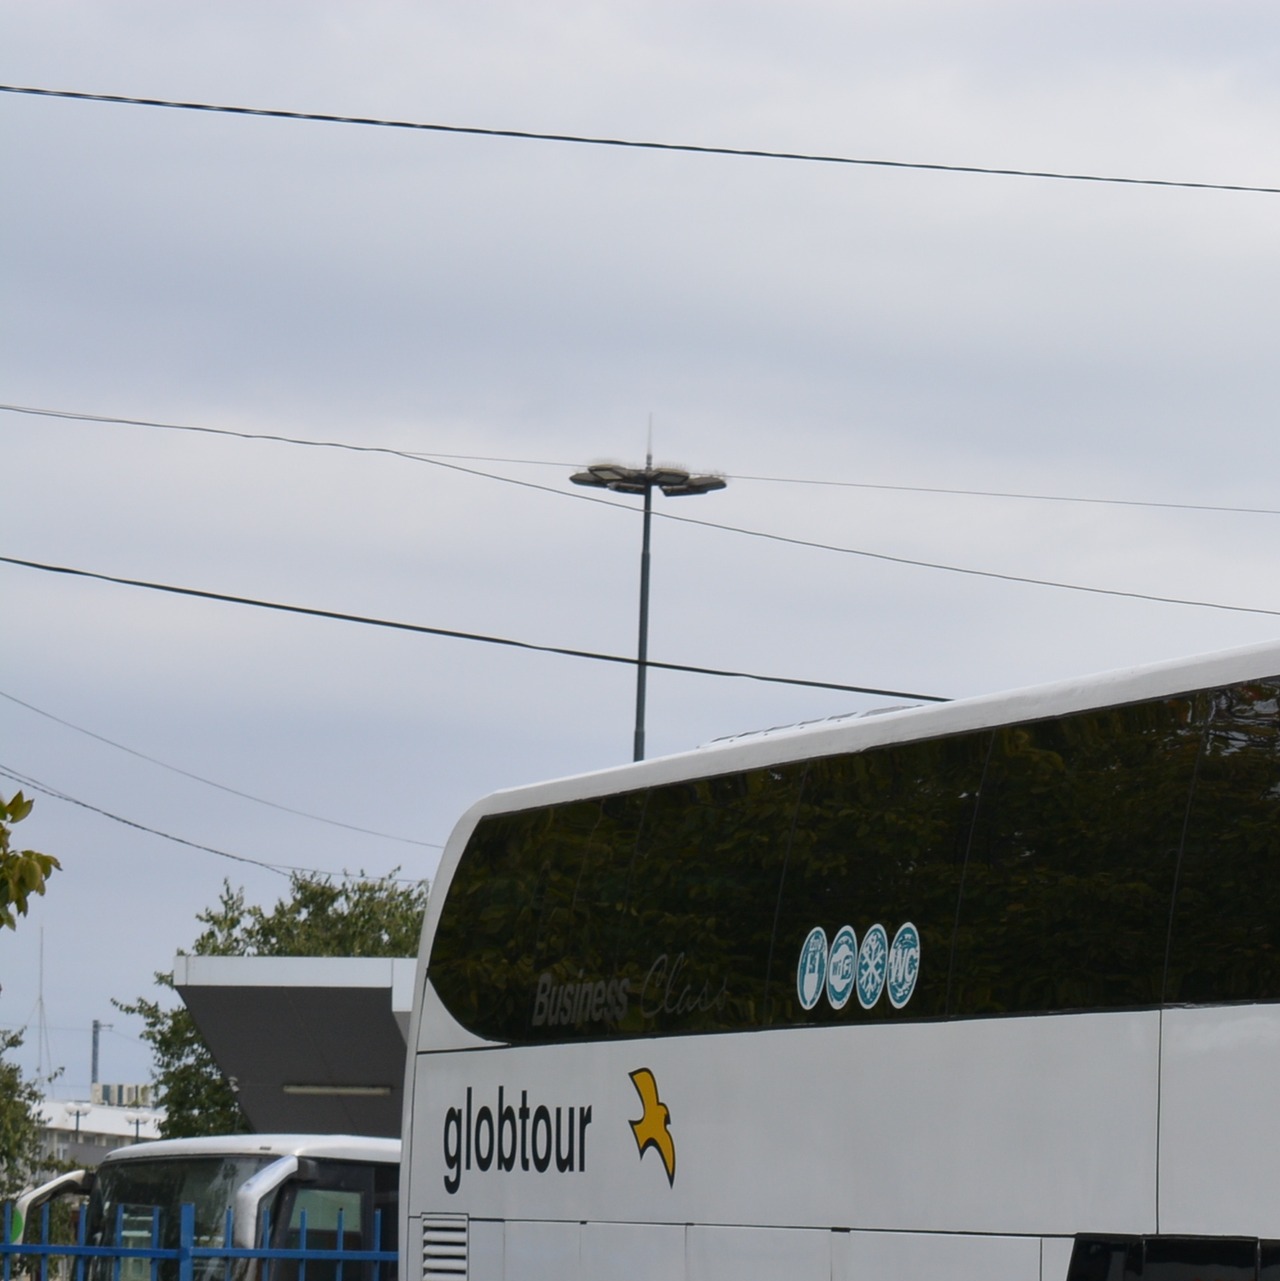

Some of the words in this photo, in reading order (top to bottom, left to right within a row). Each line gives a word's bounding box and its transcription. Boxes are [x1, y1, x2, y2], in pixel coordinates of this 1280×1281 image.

[532, 969, 631, 1026] Business
[640, 952, 731, 1019] Class
[443, 1085, 592, 1195] globtour
